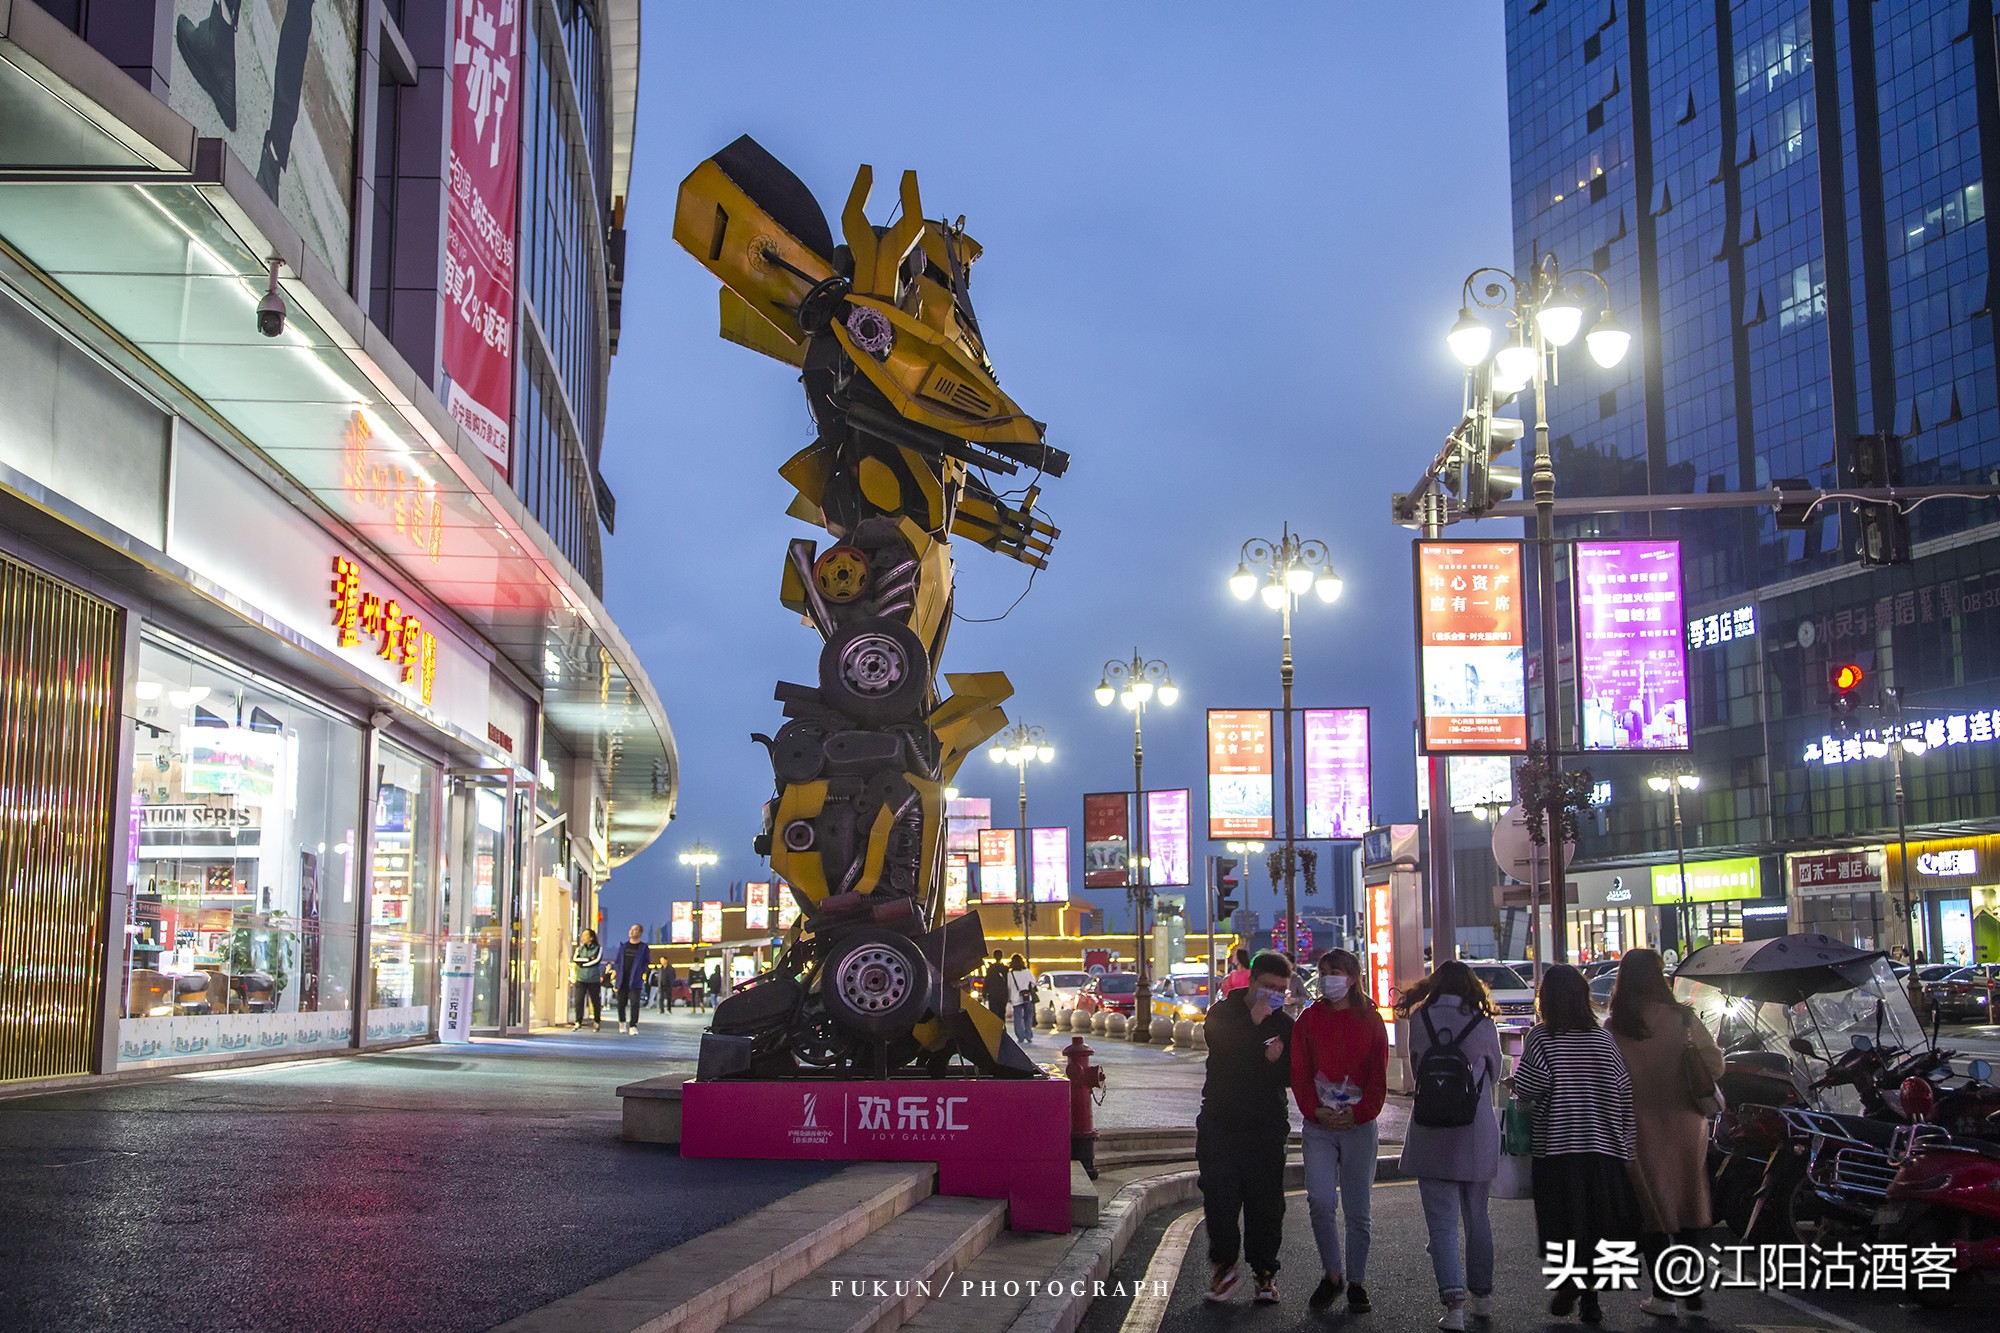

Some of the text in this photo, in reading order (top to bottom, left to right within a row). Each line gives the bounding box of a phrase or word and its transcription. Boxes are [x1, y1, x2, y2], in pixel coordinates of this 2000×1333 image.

[451, 396, 507, 455] 苏宁易购万象汇店
[1429, 574, 1510, 592] 中心资产
[1429, 594, 1511, 613] 应有一席
[330, 555, 421, 686] 泸州老窖
[1687, 611, 1733, 651] 季酒店
[1816, 595, 1916, 644] 水灵子舞蹈
[1812, 860, 1862, 882] 禾一酒店
[447, 1002, 459, 1030] 充电宝
[858, 1096, 969, 1131] 欢乐汇
[871, 1133, 956, 1141] JOY GALAXY
